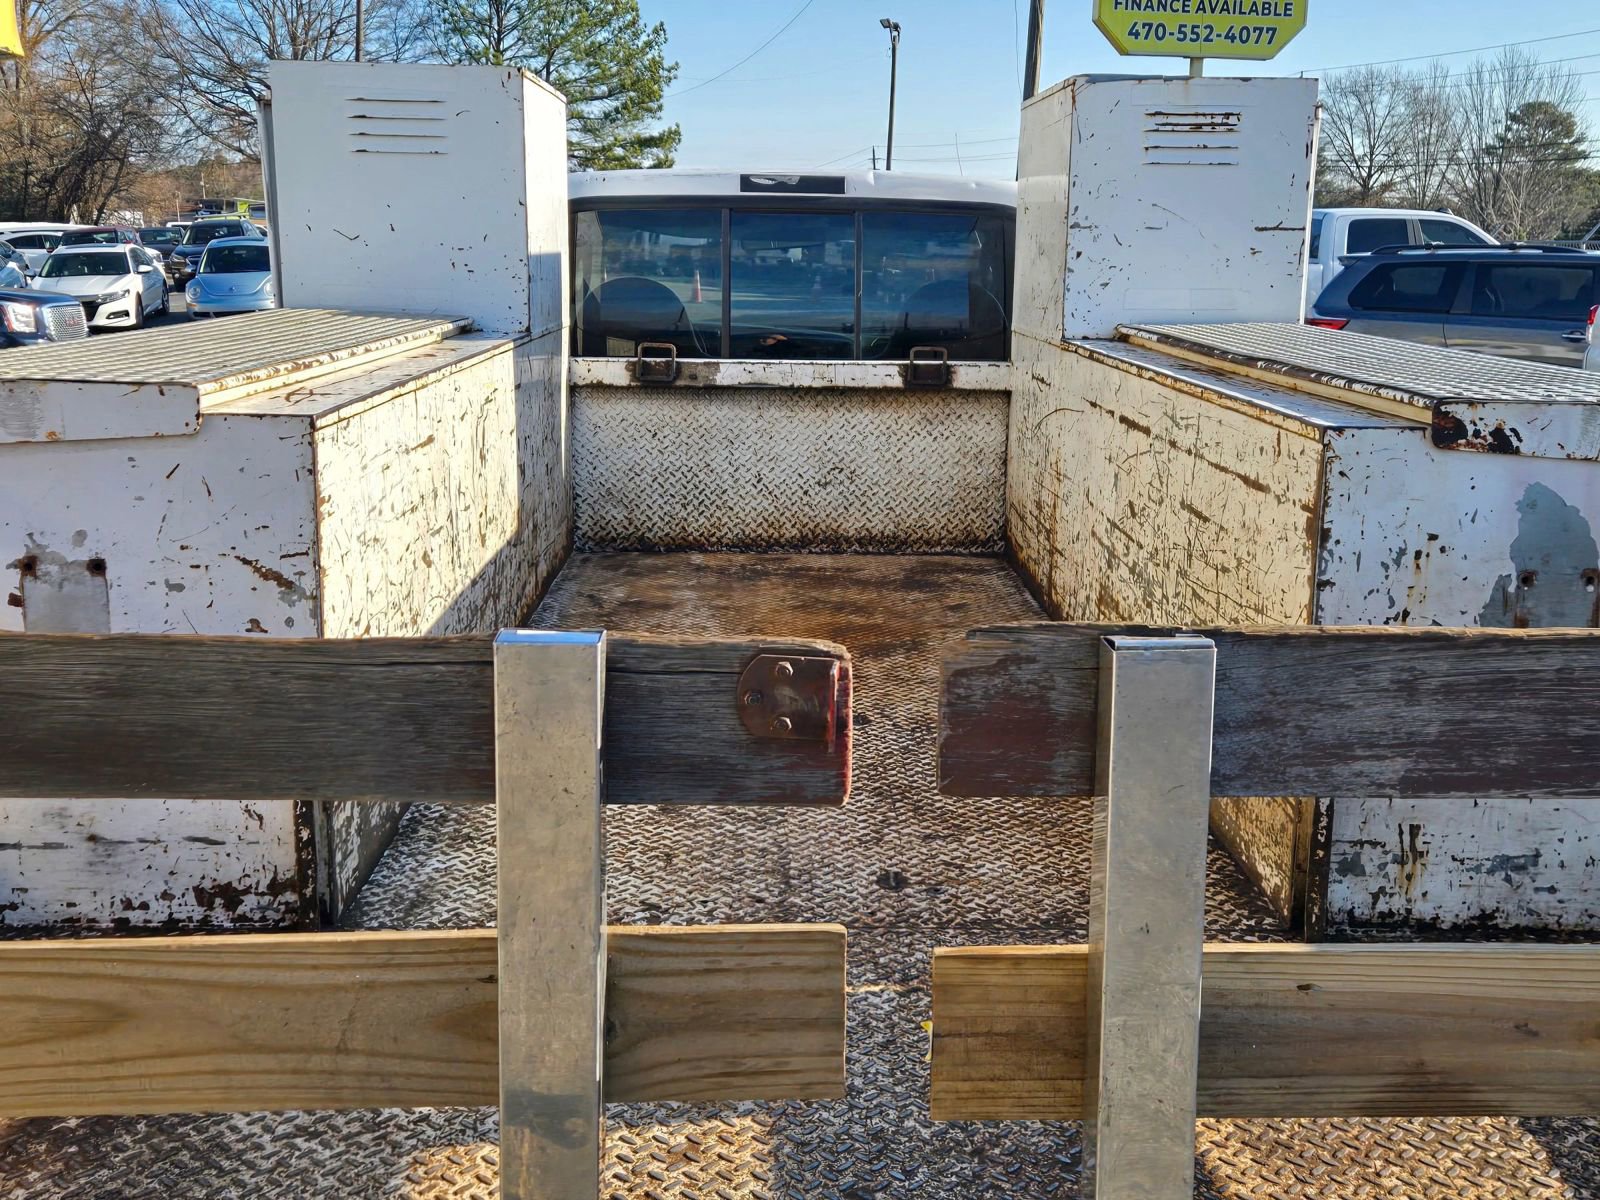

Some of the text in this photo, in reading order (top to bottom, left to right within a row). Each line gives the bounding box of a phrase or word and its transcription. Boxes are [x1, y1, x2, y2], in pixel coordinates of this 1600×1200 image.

[1114, 0, 1293, 16] FINANCE AVAILABLE
[1127, 21, 1278, 45] 470-552-4077
